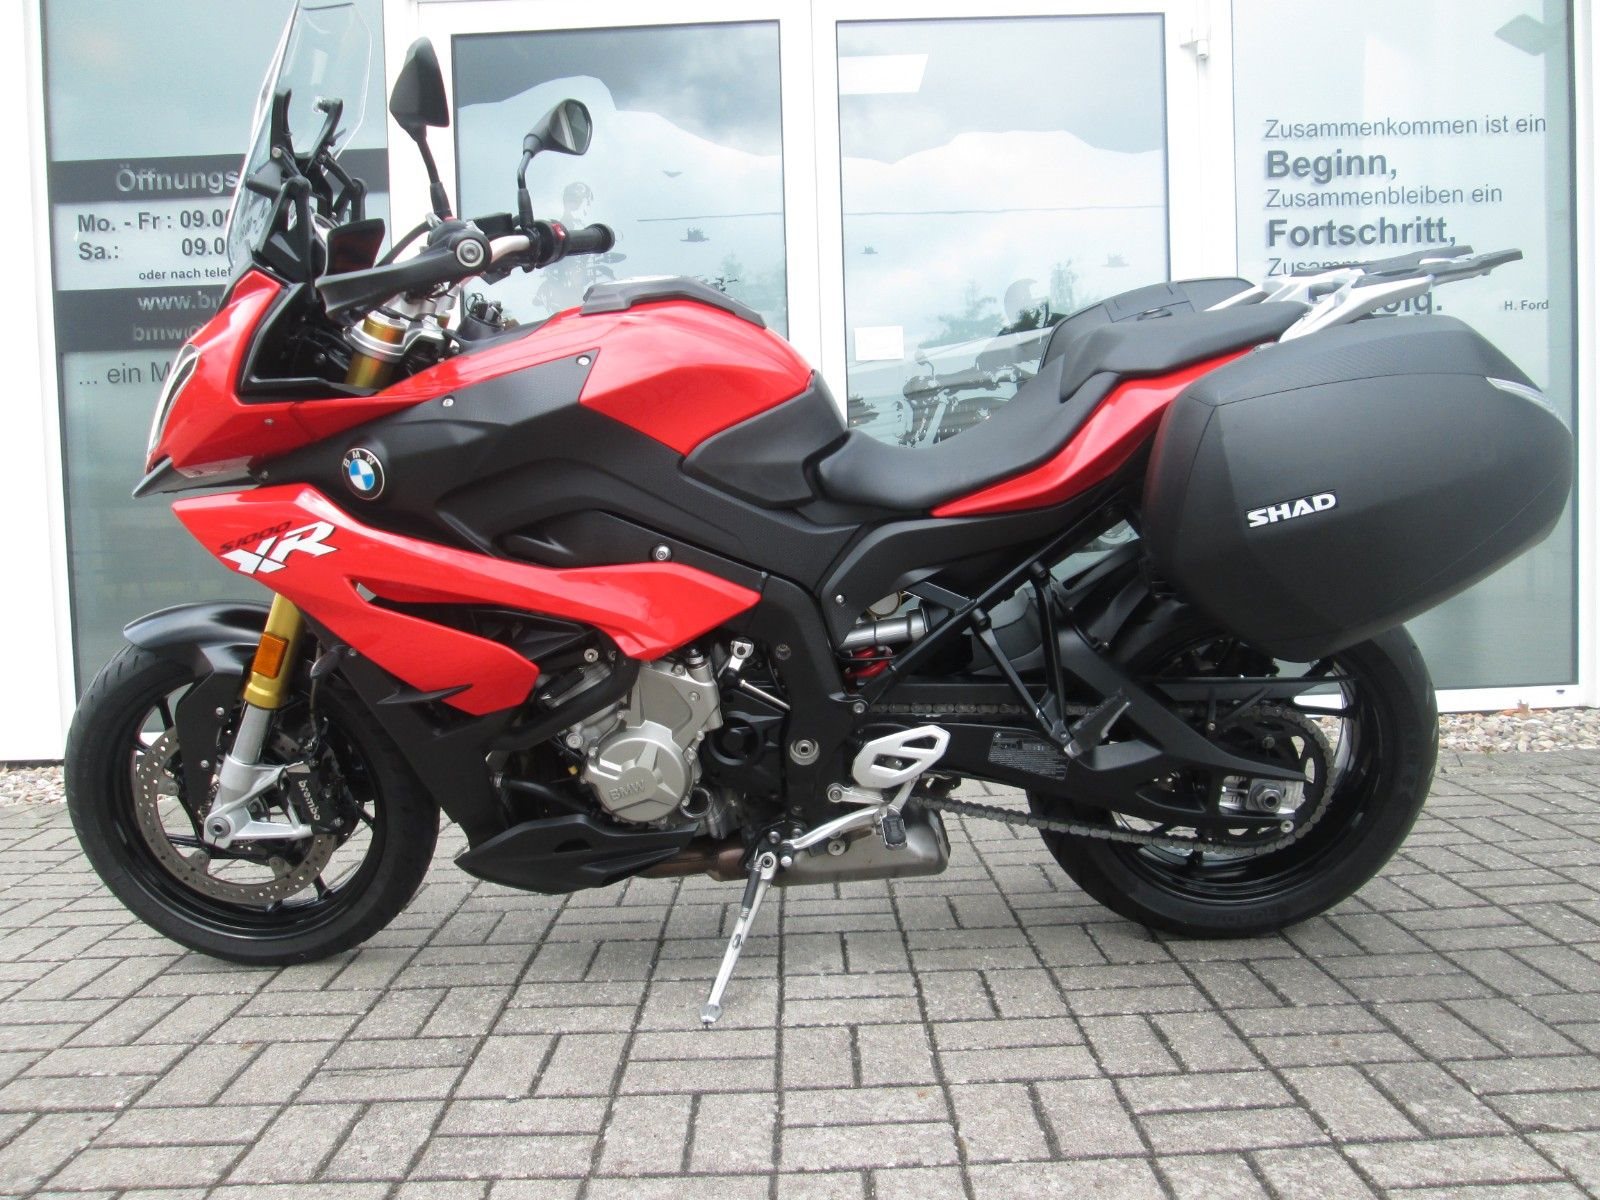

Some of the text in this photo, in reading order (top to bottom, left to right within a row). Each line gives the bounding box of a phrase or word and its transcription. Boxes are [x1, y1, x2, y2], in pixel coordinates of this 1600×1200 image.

[1264, 113, 1547, 139] Zusammenkommen ist ein
[1266, 148, 1398, 185] Beginn,
[1266, 184, 1503, 208] Zusammenbleiben ein
[78, 213, 117, 232] Mo.
[1268, 216, 1457, 247] Fortschritt,
[138, 269, 167, 281] oder
[170, 267, 202, 279] nach
[1504, 299, 1549, 311] H. Ford
[107, 362, 141, 384] ein
[1247, 492, 1337, 528] SHAD
[298, 779, 321, 821] brembo
[609, 779, 646, 801] BMW
